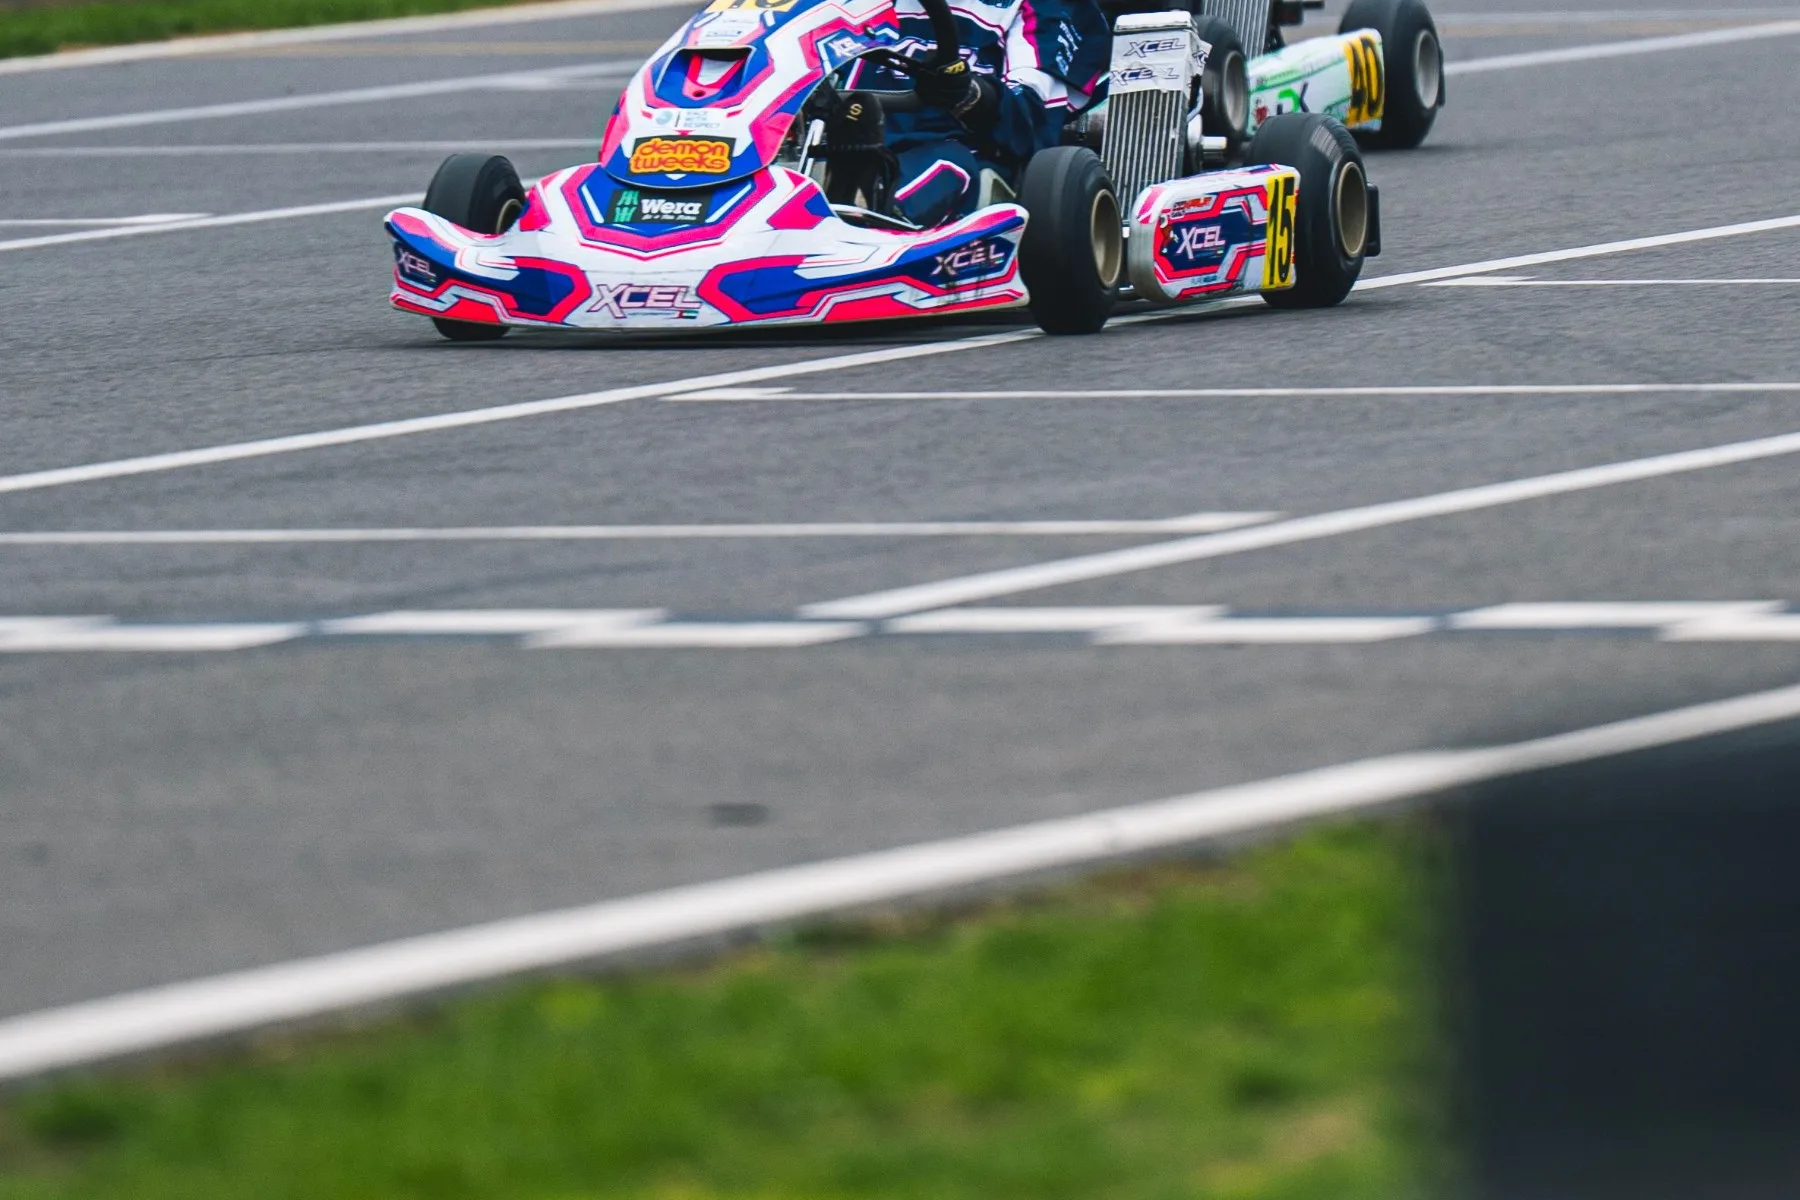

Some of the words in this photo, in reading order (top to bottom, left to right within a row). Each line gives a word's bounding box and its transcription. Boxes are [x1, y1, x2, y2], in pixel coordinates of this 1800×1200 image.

[1123, 38, 1186, 59] XCEL
[1350, 35, 1385, 119] 40
[634, 154, 726, 170] tweeks
[640, 140, 725, 156] demon
[641, 199, 702, 215] Wera
[1176, 225, 1226, 260] XCEL
[1268, 176, 1295, 286] 15
[398, 247, 437, 274] XCEL
[929, 244, 1005, 276] XCEL
[586, 283, 704, 319] XCEL
